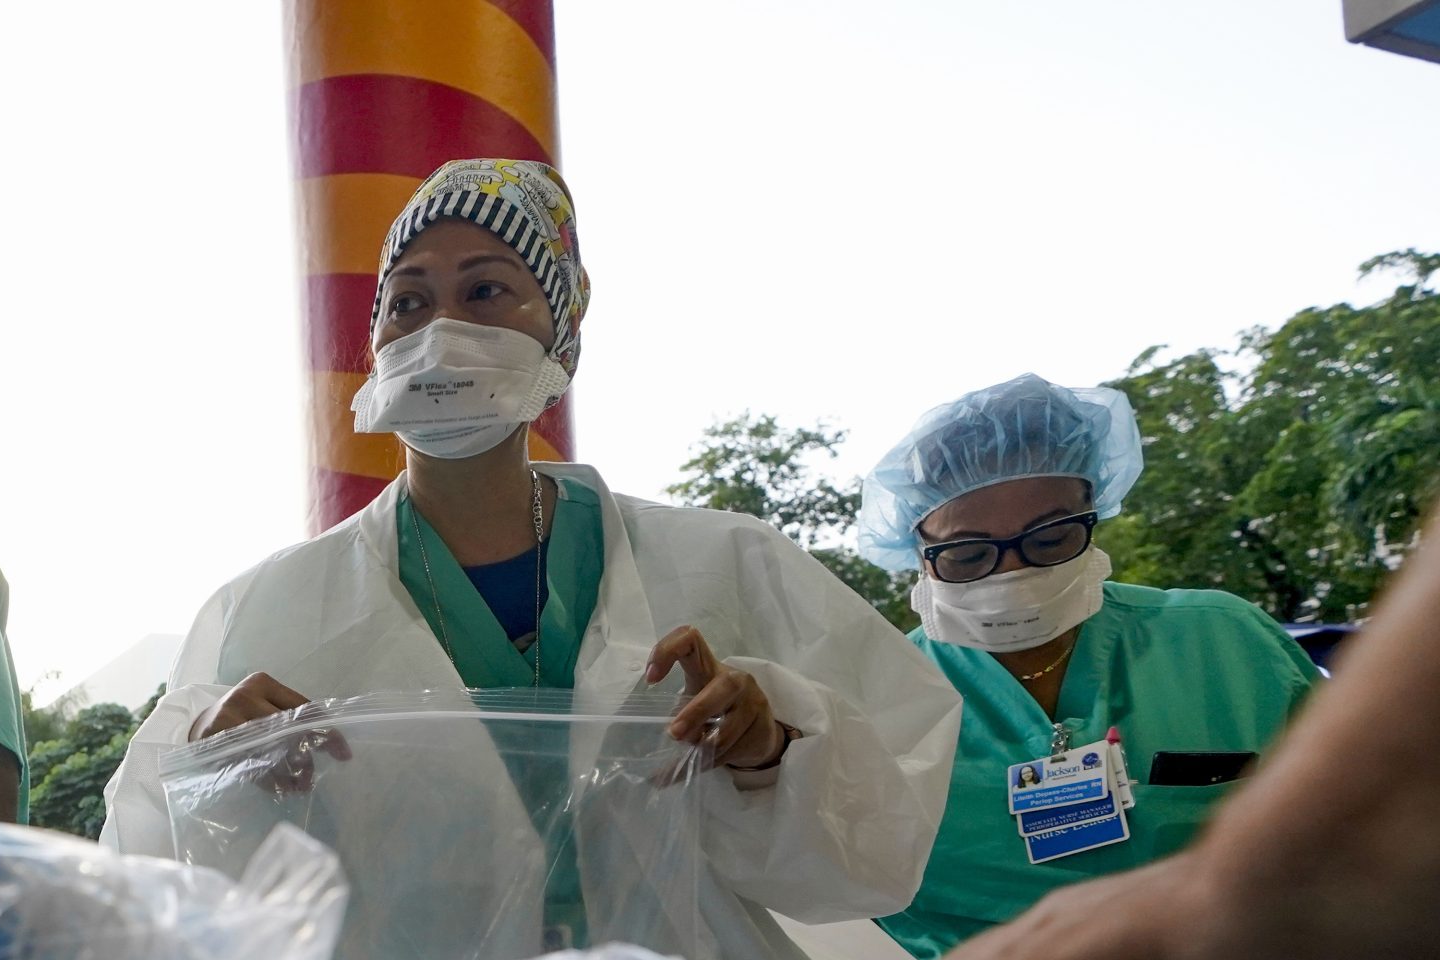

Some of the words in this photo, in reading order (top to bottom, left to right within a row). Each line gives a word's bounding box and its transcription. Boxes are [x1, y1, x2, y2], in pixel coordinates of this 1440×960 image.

[408, 383, 422, 392] 3M
[1046, 764, 1081, 778] Jackson
[1053, 791, 1085, 803] Services
